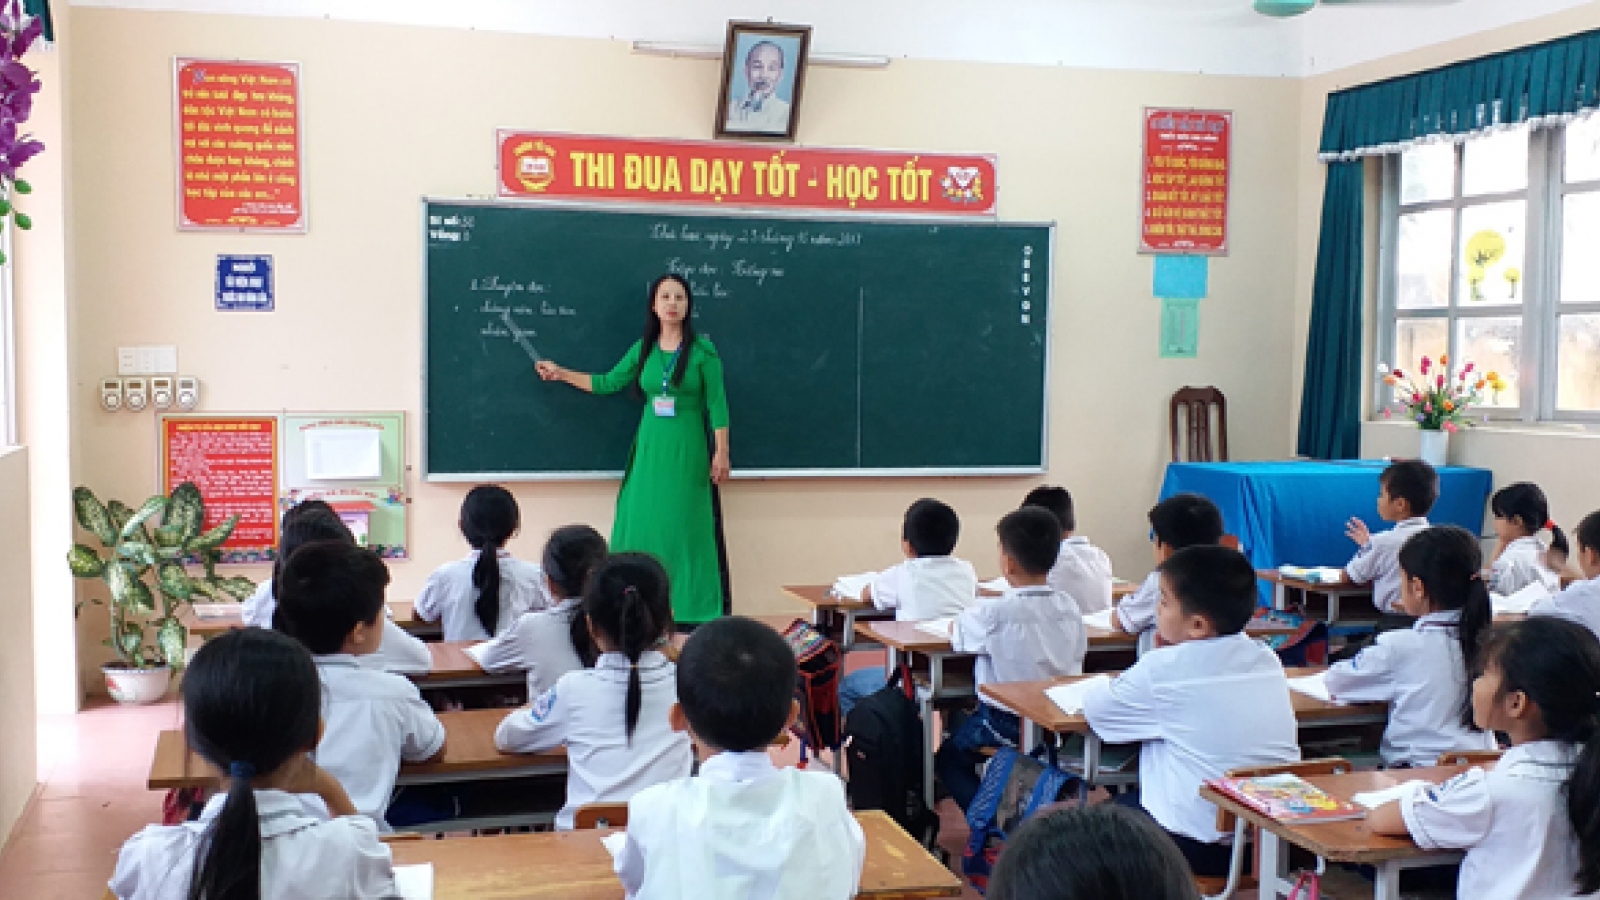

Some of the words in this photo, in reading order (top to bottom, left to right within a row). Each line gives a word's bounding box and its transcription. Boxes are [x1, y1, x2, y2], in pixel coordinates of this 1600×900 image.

[570, 151, 615, 191] THI
[623, 155, 683, 194] ĐUA
[691, 158, 745, 203] DẠY
[753, 149, 801, 198] TỐT
[826, 163, 879, 209] HỌC
[888, 155, 932, 203] TỐT
